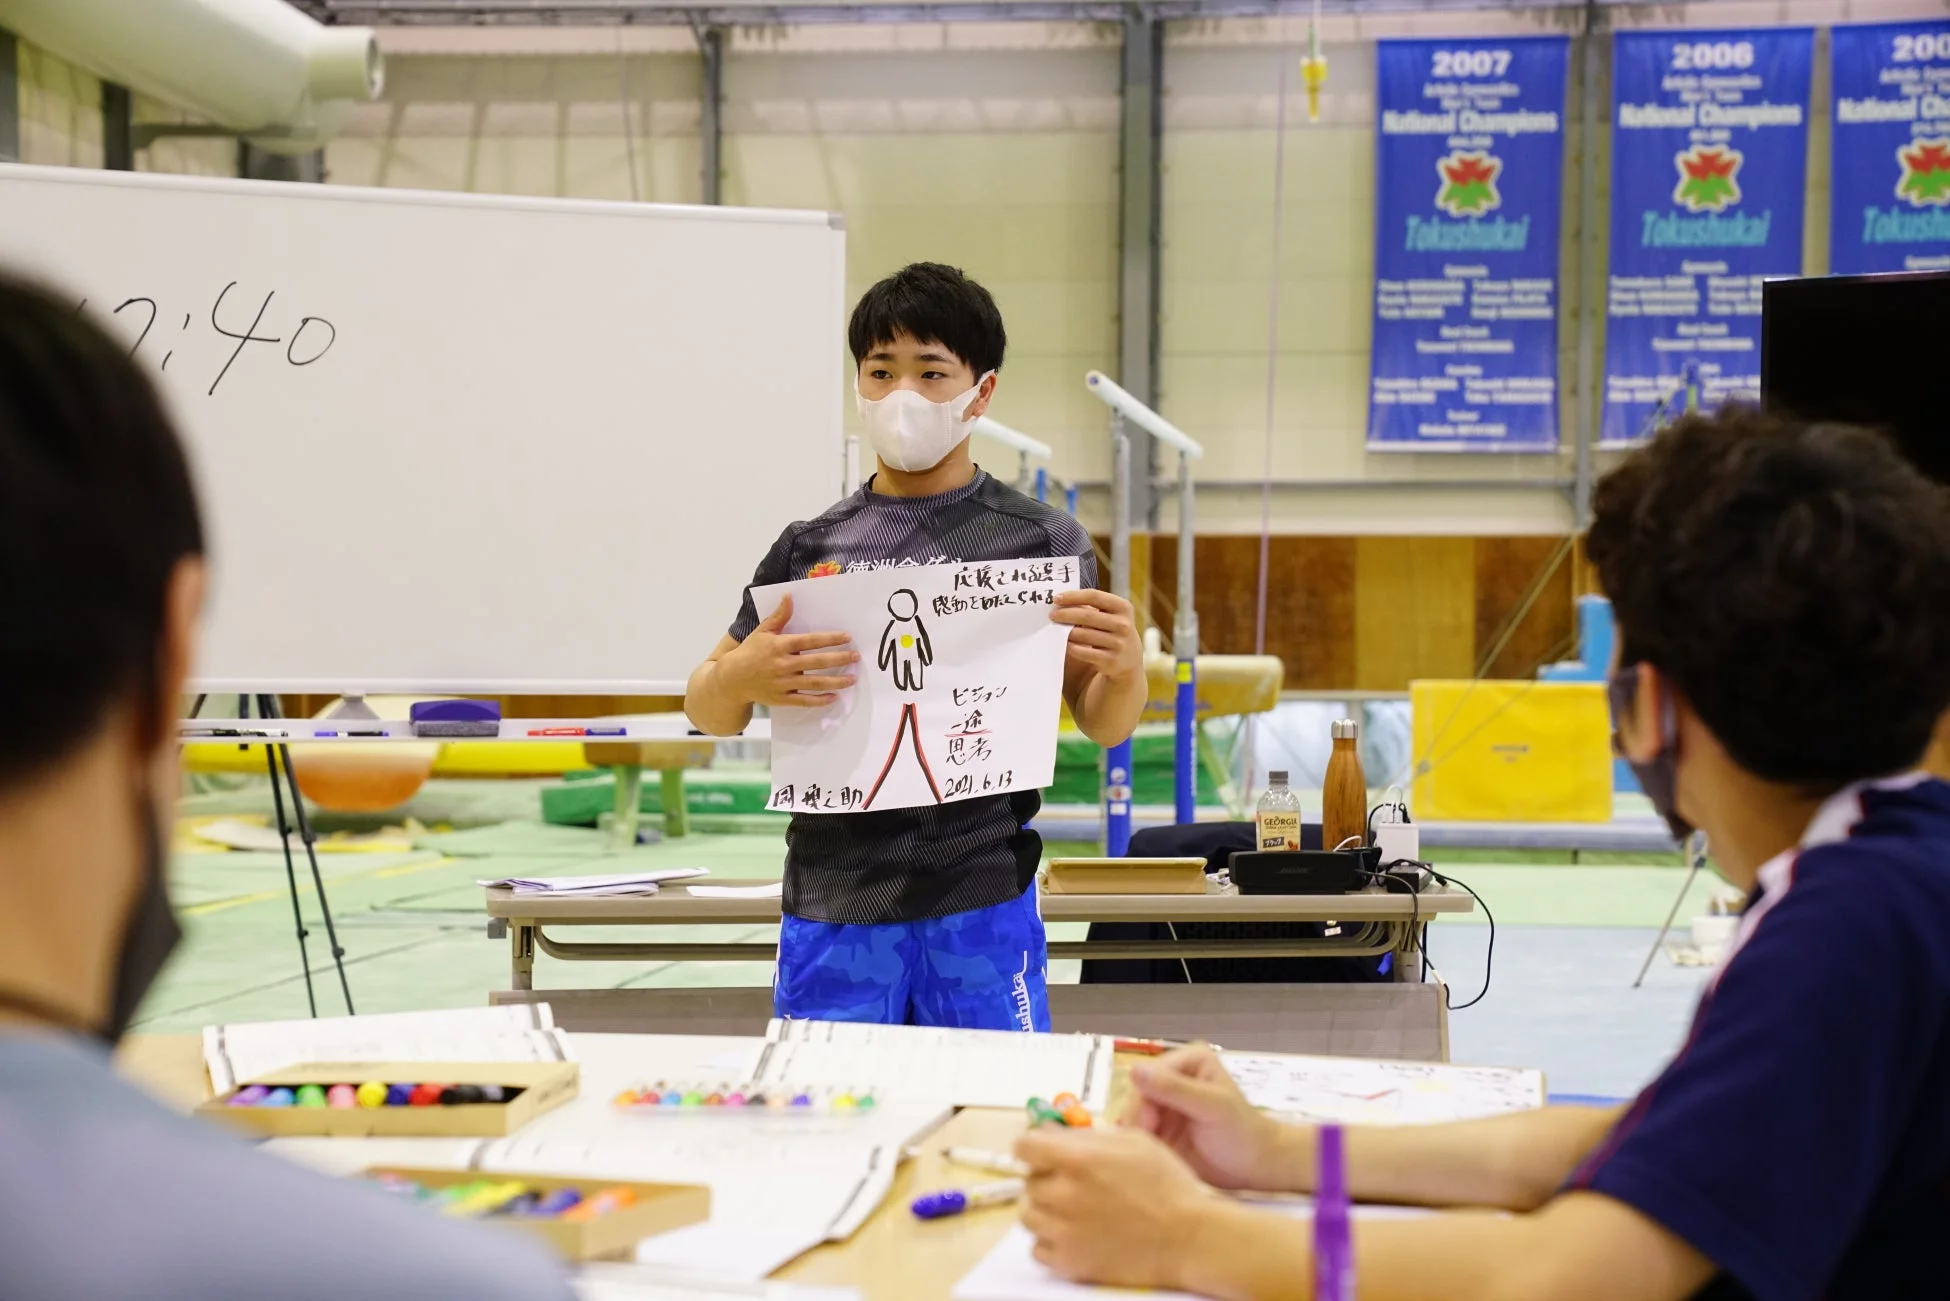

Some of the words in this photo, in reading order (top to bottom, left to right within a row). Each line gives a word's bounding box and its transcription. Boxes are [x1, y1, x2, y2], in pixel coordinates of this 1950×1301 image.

[1431, 50, 1513, 77] 2007
[1619, 103, 1695, 128] National
[1699, 101, 1802, 130] Champions
[1837, 97, 1917, 122] National
[1382, 110, 1456, 134] National
[1459, 110, 1558, 137] Champions
[75, 281, 335, 396] 7:40
[952, 686, 1007, 706] ビジョン
[950, 709, 983, 734] 一途
[946, 737, 992, 765] 思考
